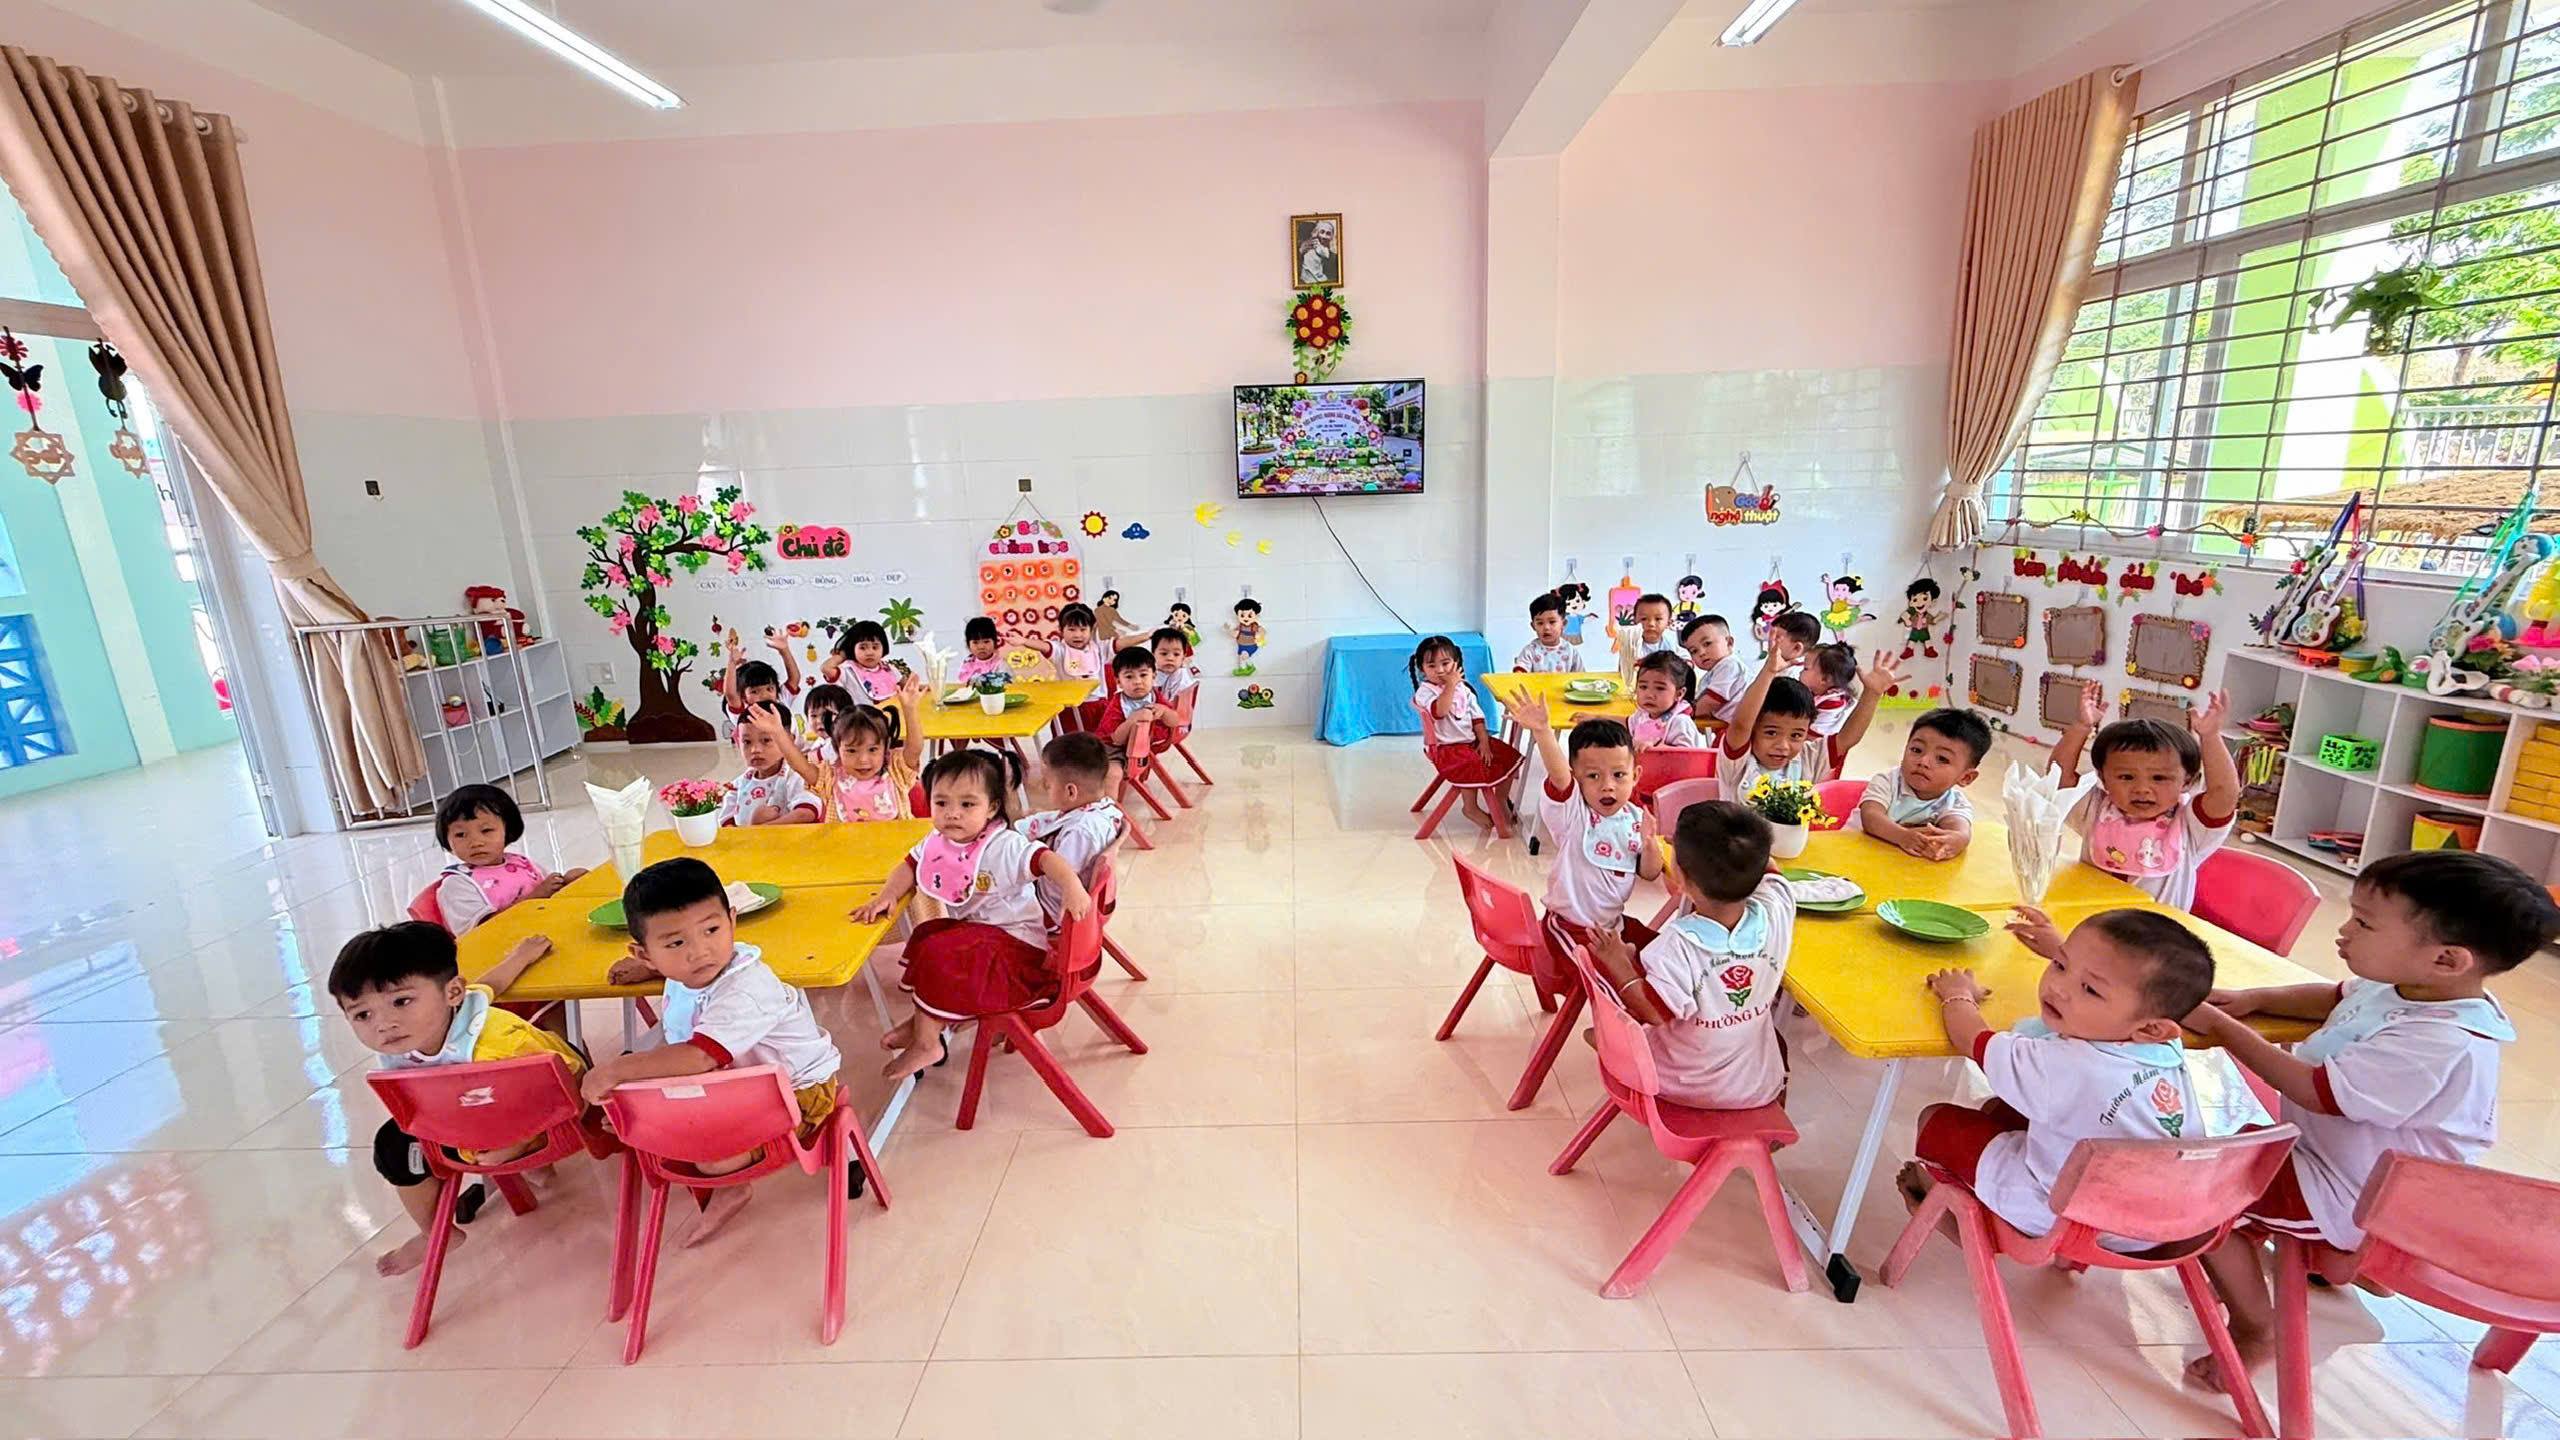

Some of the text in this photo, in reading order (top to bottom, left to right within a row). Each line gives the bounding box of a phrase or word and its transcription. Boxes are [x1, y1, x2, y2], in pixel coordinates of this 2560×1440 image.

[783, 530, 848, 557] Chủ đề
[1694, 1009, 1752, 1029] PHƯỜNG
